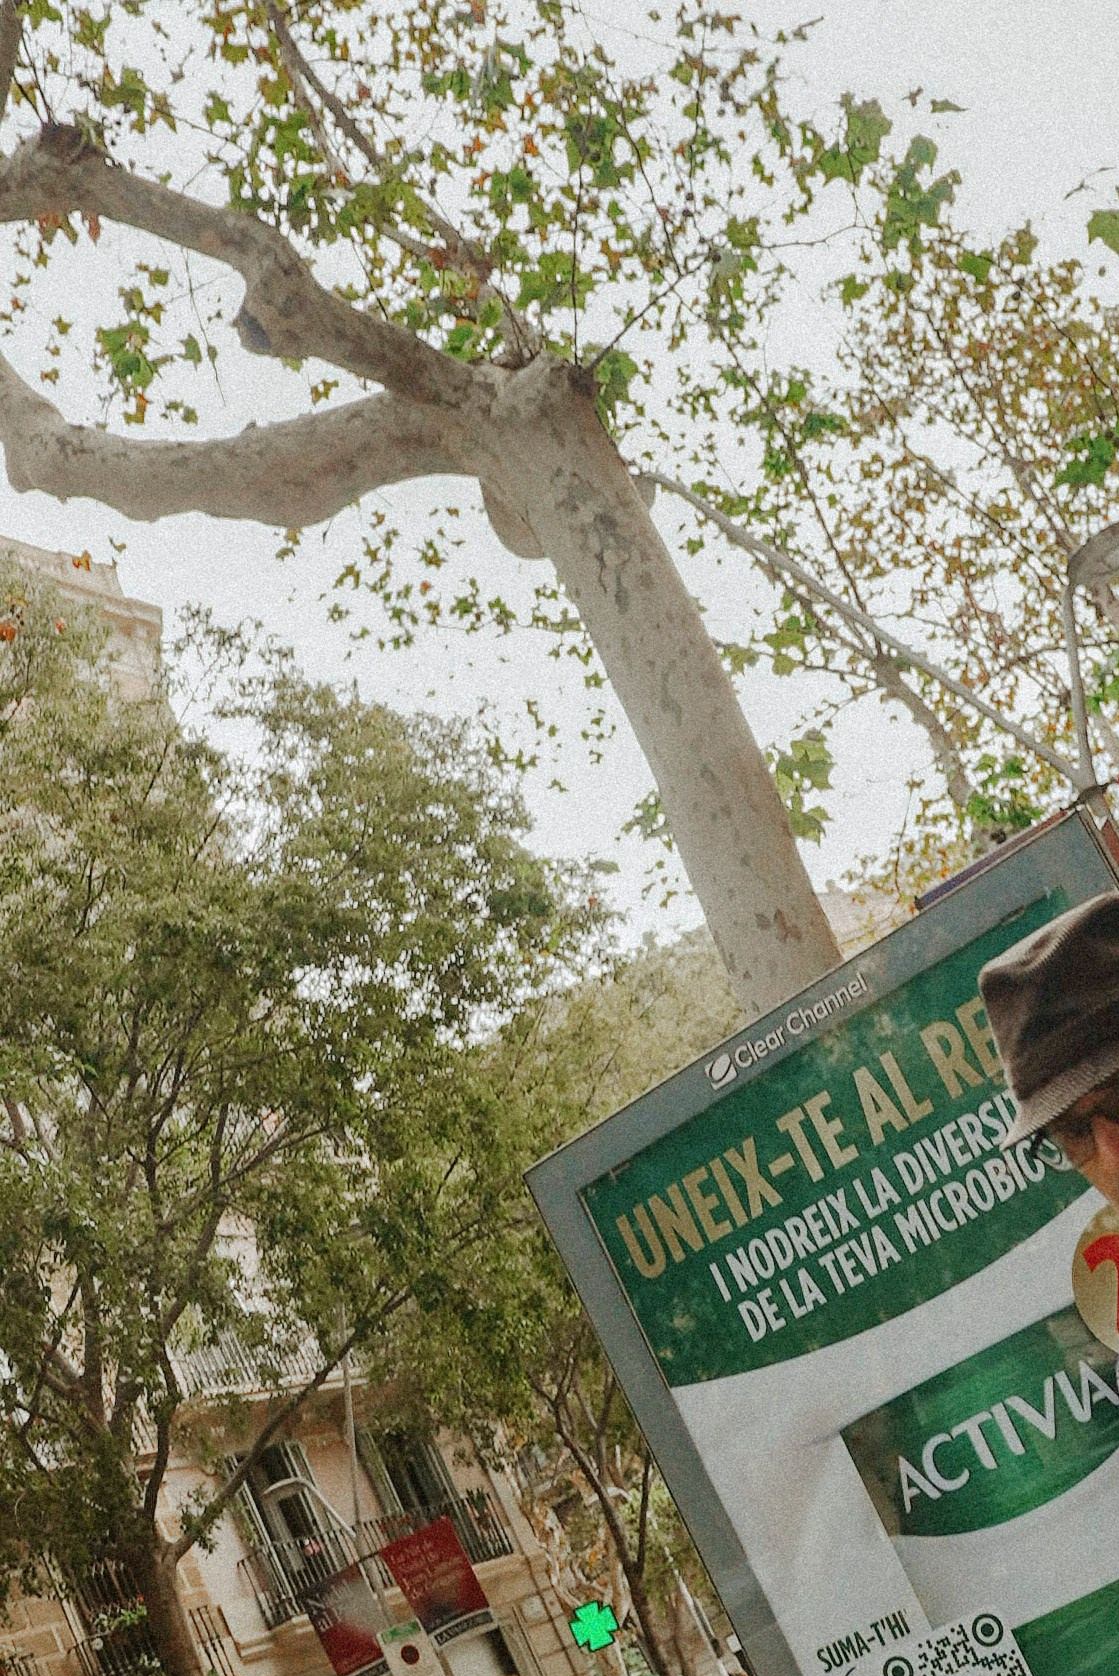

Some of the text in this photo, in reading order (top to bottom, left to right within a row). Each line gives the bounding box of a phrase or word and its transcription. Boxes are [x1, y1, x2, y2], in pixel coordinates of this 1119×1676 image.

[734, 971, 868, 1068] Clear Channel
[615, 996, 1007, 1279] UNEIX-TE AL RE
[709, 1088, 1022, 1302] I NODREIX LA DIVERSIT
[737, 1288, 787, 1343] DE
[779, 1267, 828, 1319] LA
[818, 1224, 902, 1295] TEVA
